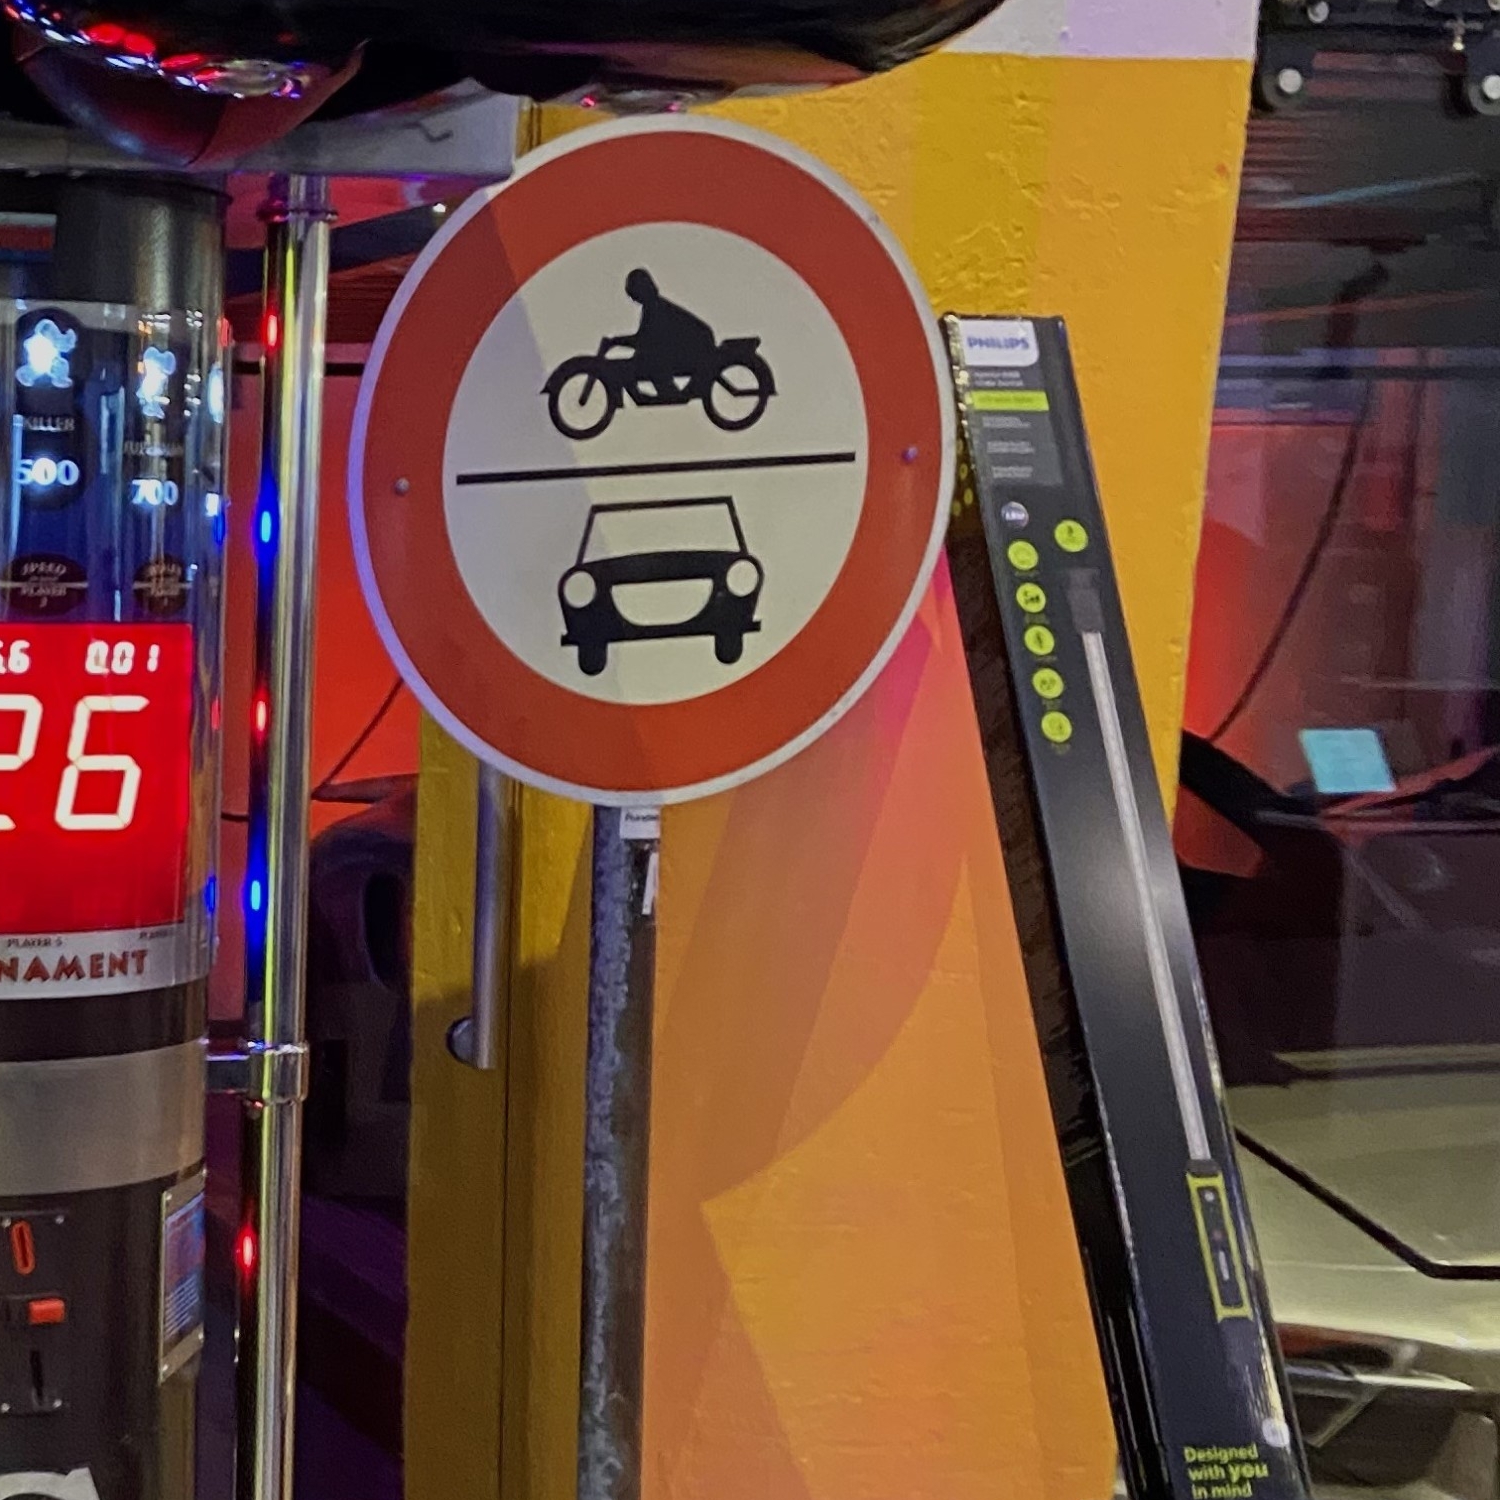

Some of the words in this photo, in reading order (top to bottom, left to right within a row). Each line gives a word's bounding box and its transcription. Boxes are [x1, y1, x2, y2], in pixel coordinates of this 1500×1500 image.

[966, 336, 1030, 350] PHILIPS
[15, 457, 80, 487] 500
[131, 478, 179, 506] 700
[1183, 1442, 1259, 1464] Designed
[1188, 1464, 1226, 1481] with
[1228, 1462, 1269, 1484] you
[1191, 1483, 1208, 1500] in
[1211, 1480, 1253, 1499] mind
